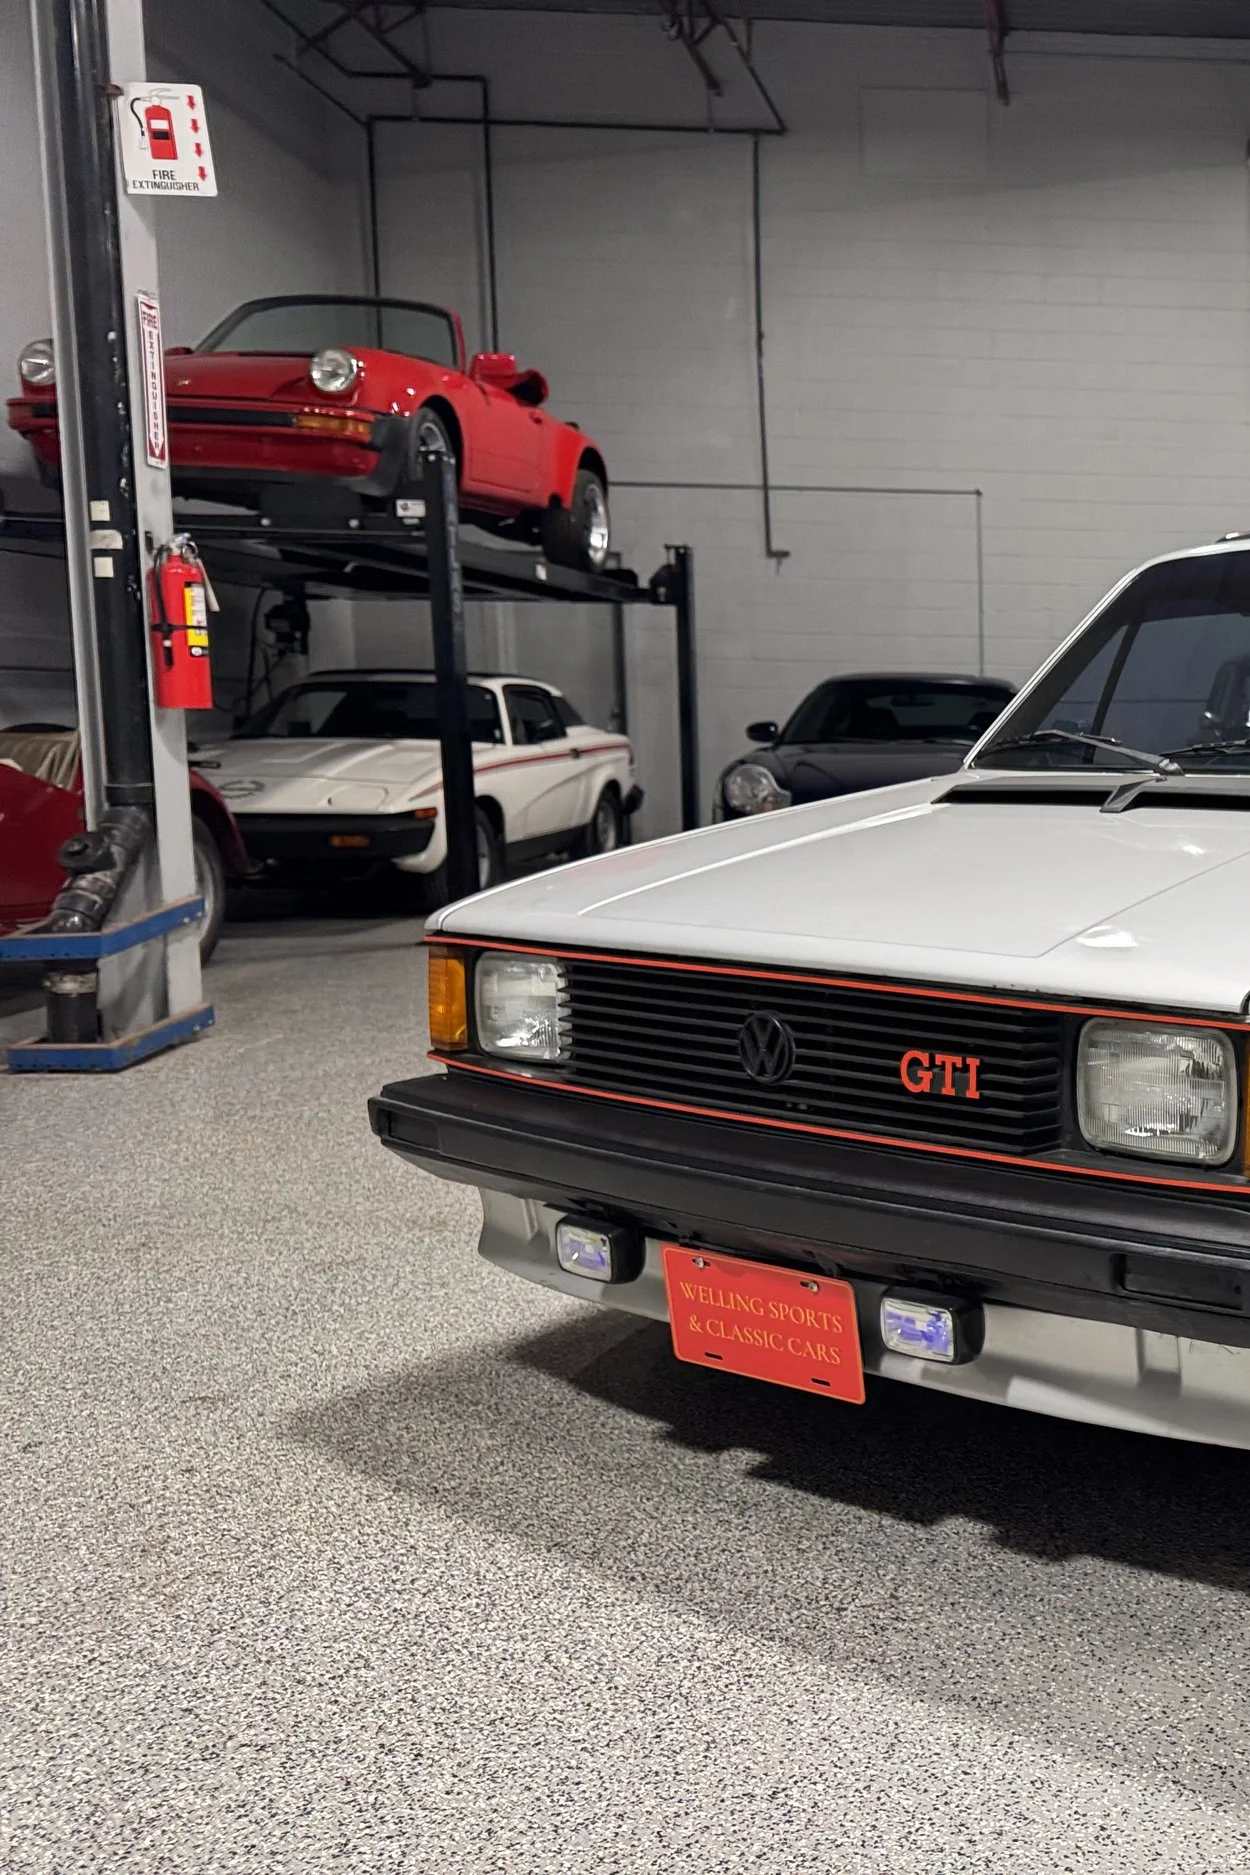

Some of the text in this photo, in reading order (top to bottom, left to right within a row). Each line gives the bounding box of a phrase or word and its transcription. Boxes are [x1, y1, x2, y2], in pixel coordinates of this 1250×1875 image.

[132, 180, 200, 191] EXTINGUISHER
[152, 169, 176, 180] FIRE
[148, 330, 160, 449] EXTINGUISHER
[900, 1050, 980, 1099] GTI
[680, 1281, 843, 1333] WELLING SPORTS
[689, 1314, 841, 1365] & CLASSIC CARS
